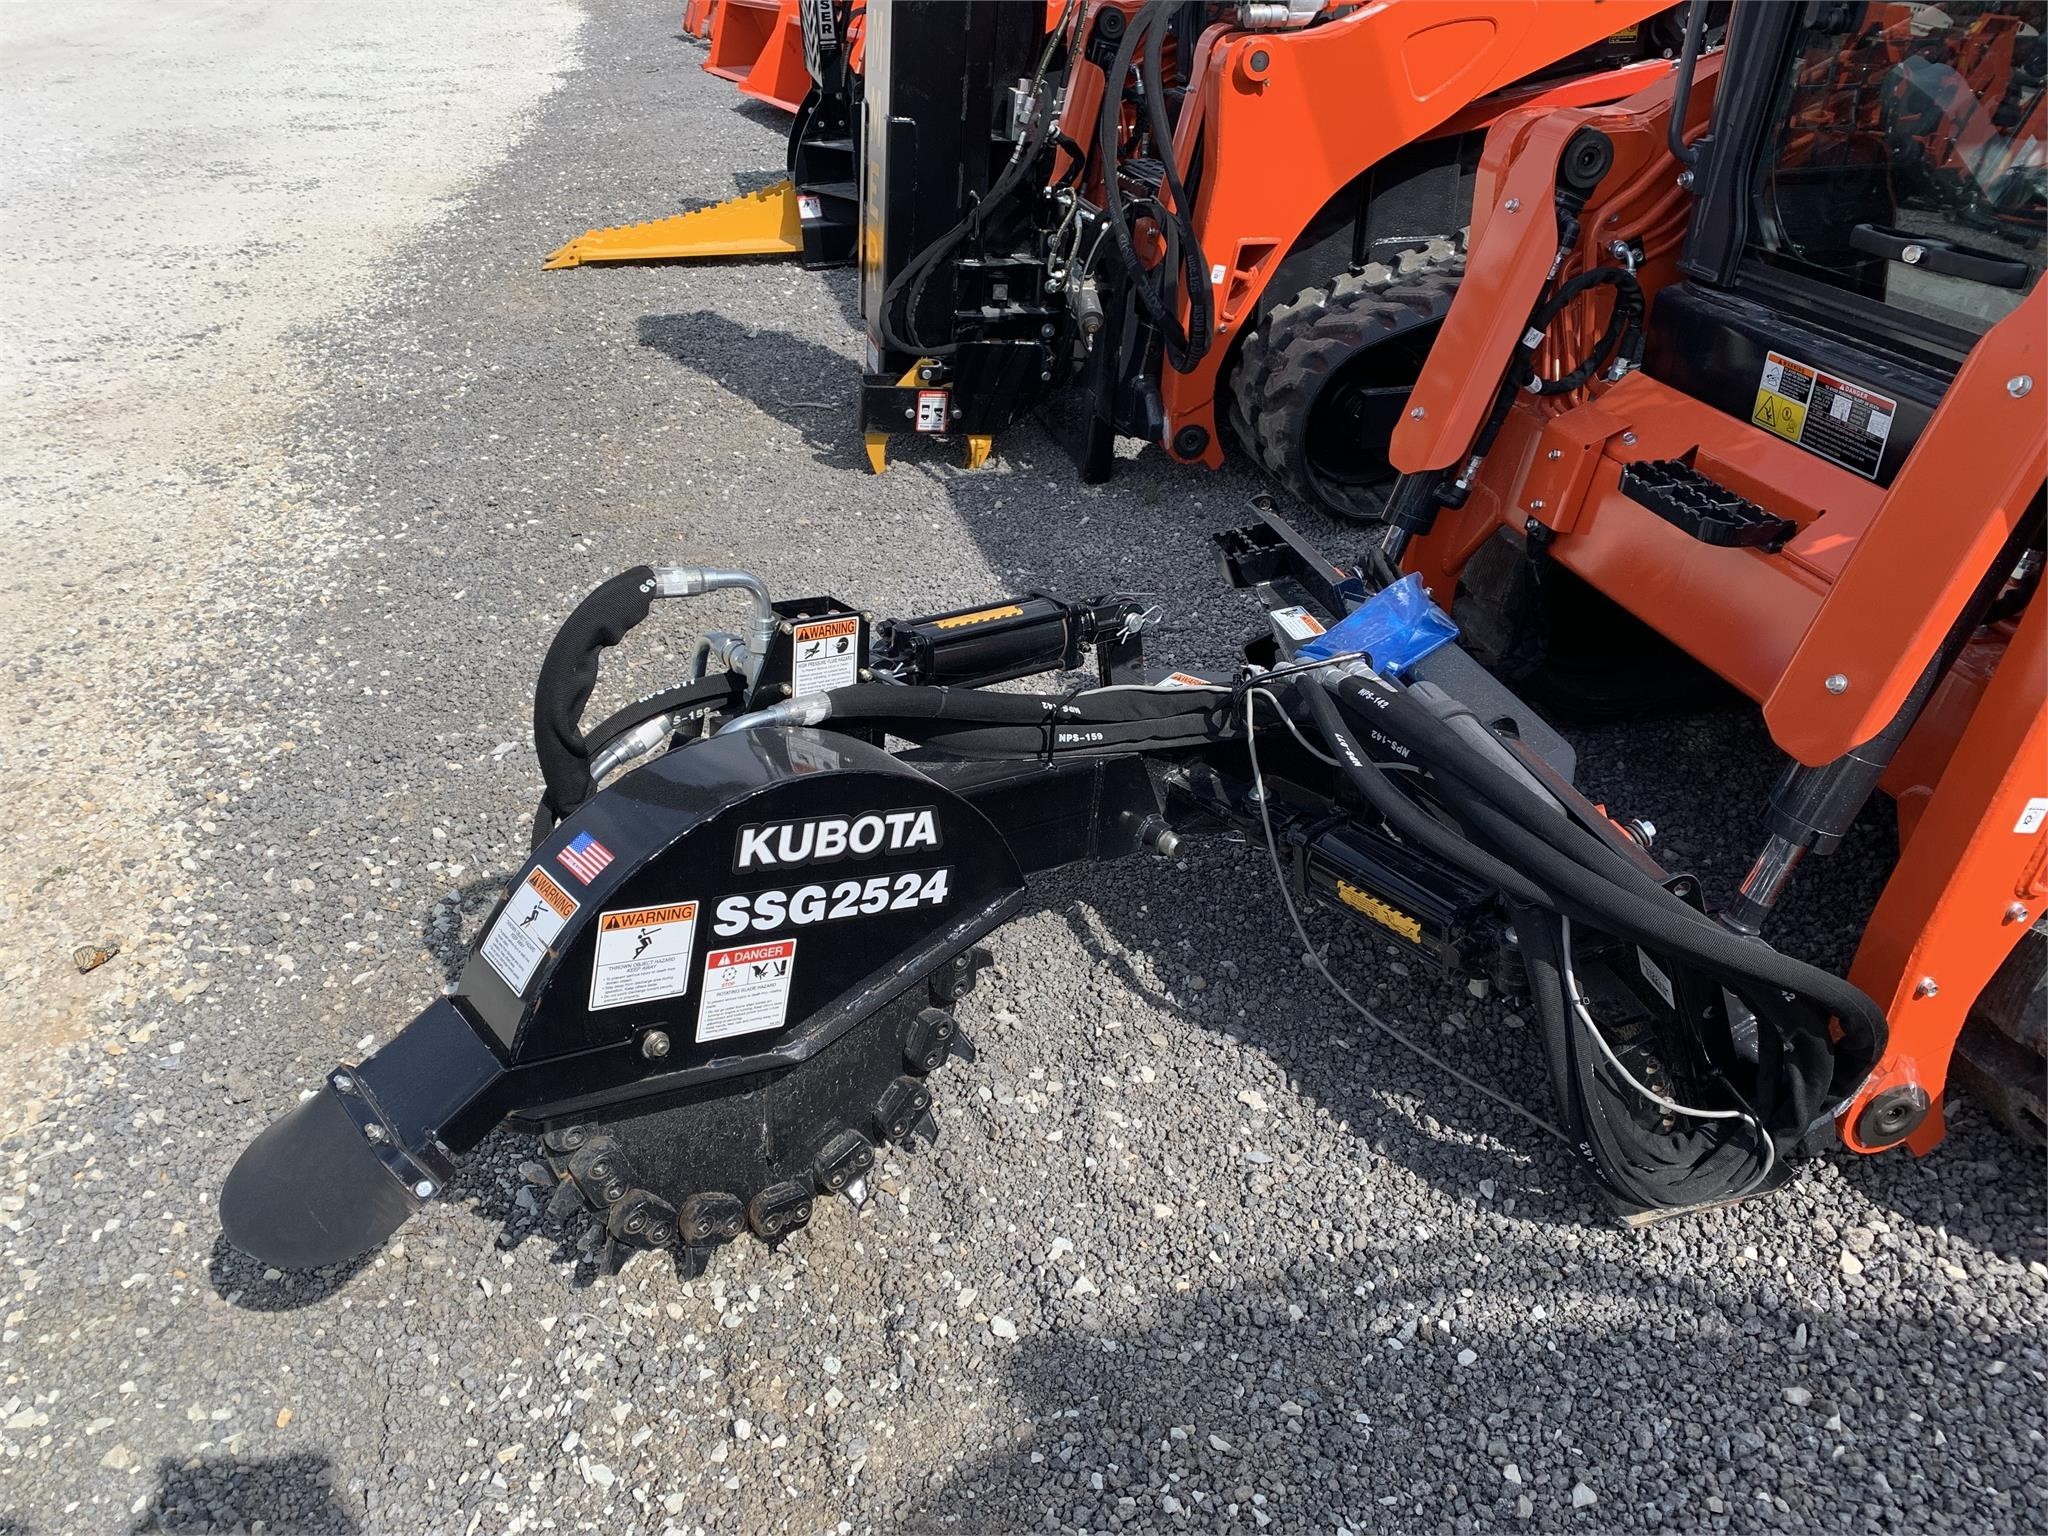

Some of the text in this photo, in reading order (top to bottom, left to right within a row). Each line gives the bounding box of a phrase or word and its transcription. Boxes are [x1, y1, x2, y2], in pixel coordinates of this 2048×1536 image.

[1845, 386, 1869, 400] DANGER
[809, 621, 855, 638] WARNING
[1358, 687, 1390, 709] NPS-142
[1058, 732, 1104, 742] NPS-159
[1371, 729, 1411, 759] NPS-142
[738, 810, 938, 868] KUBOTA
[536, 875, 575, 917] WARNING
[713, 869, 949, 937] SSG2524
[621, 906, 693, 927] WARNING
[734, 946, 784, 963] DANGER
